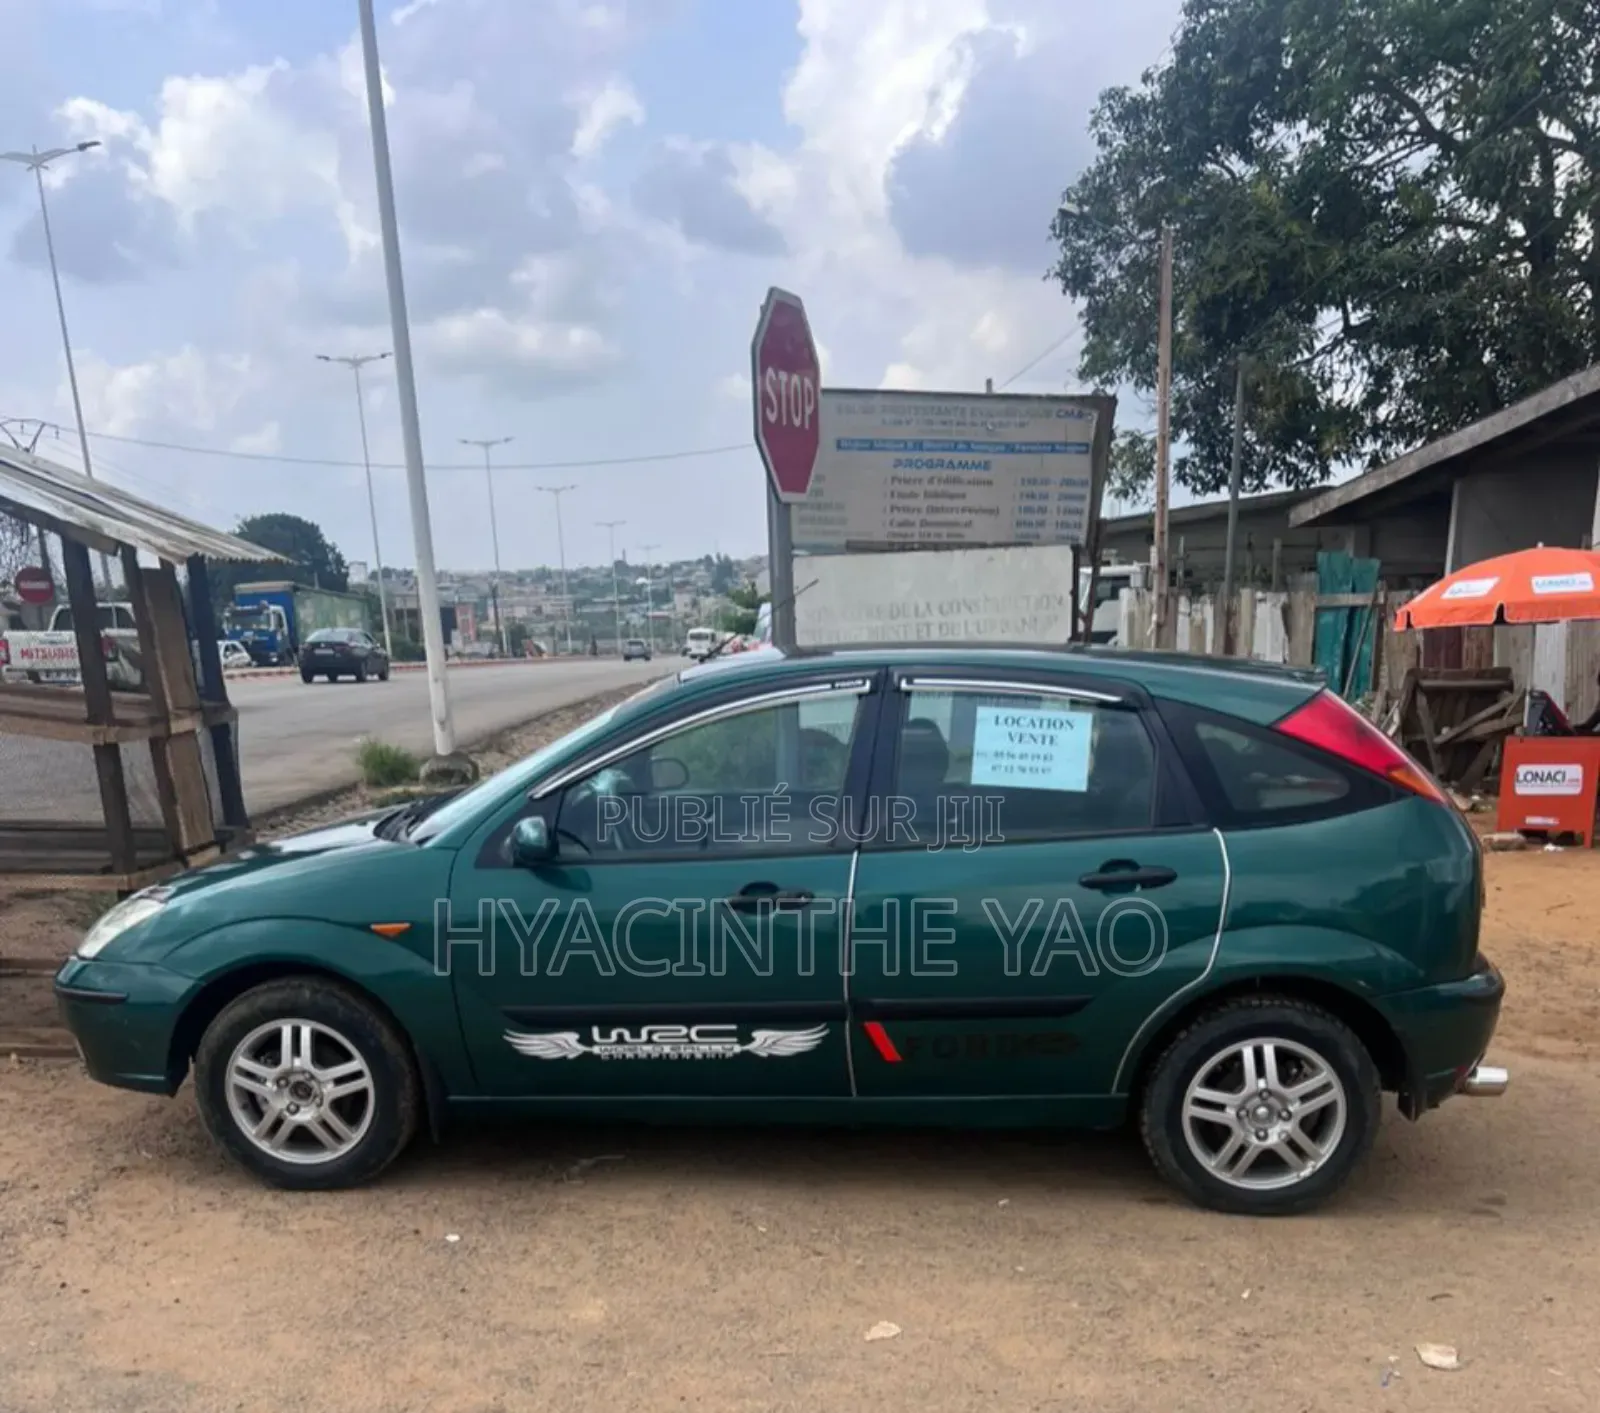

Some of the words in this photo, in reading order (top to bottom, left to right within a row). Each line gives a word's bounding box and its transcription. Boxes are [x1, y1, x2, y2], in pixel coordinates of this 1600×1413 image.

[765, 365, 815, 430] STOP
[893, 458, 991, 471] PROGRAMME
[21, 647, 77, 660] MITSUBIS
[994, 714, 1075, 730] LOCATION
[1008, 731, 1058, 746] VENTE
[1517, 771, 1566, 785] LONACI
[592, 1024, 738, 1044] WRC
[600, 1052, 735, 1061] CHAMPIONSHIP
